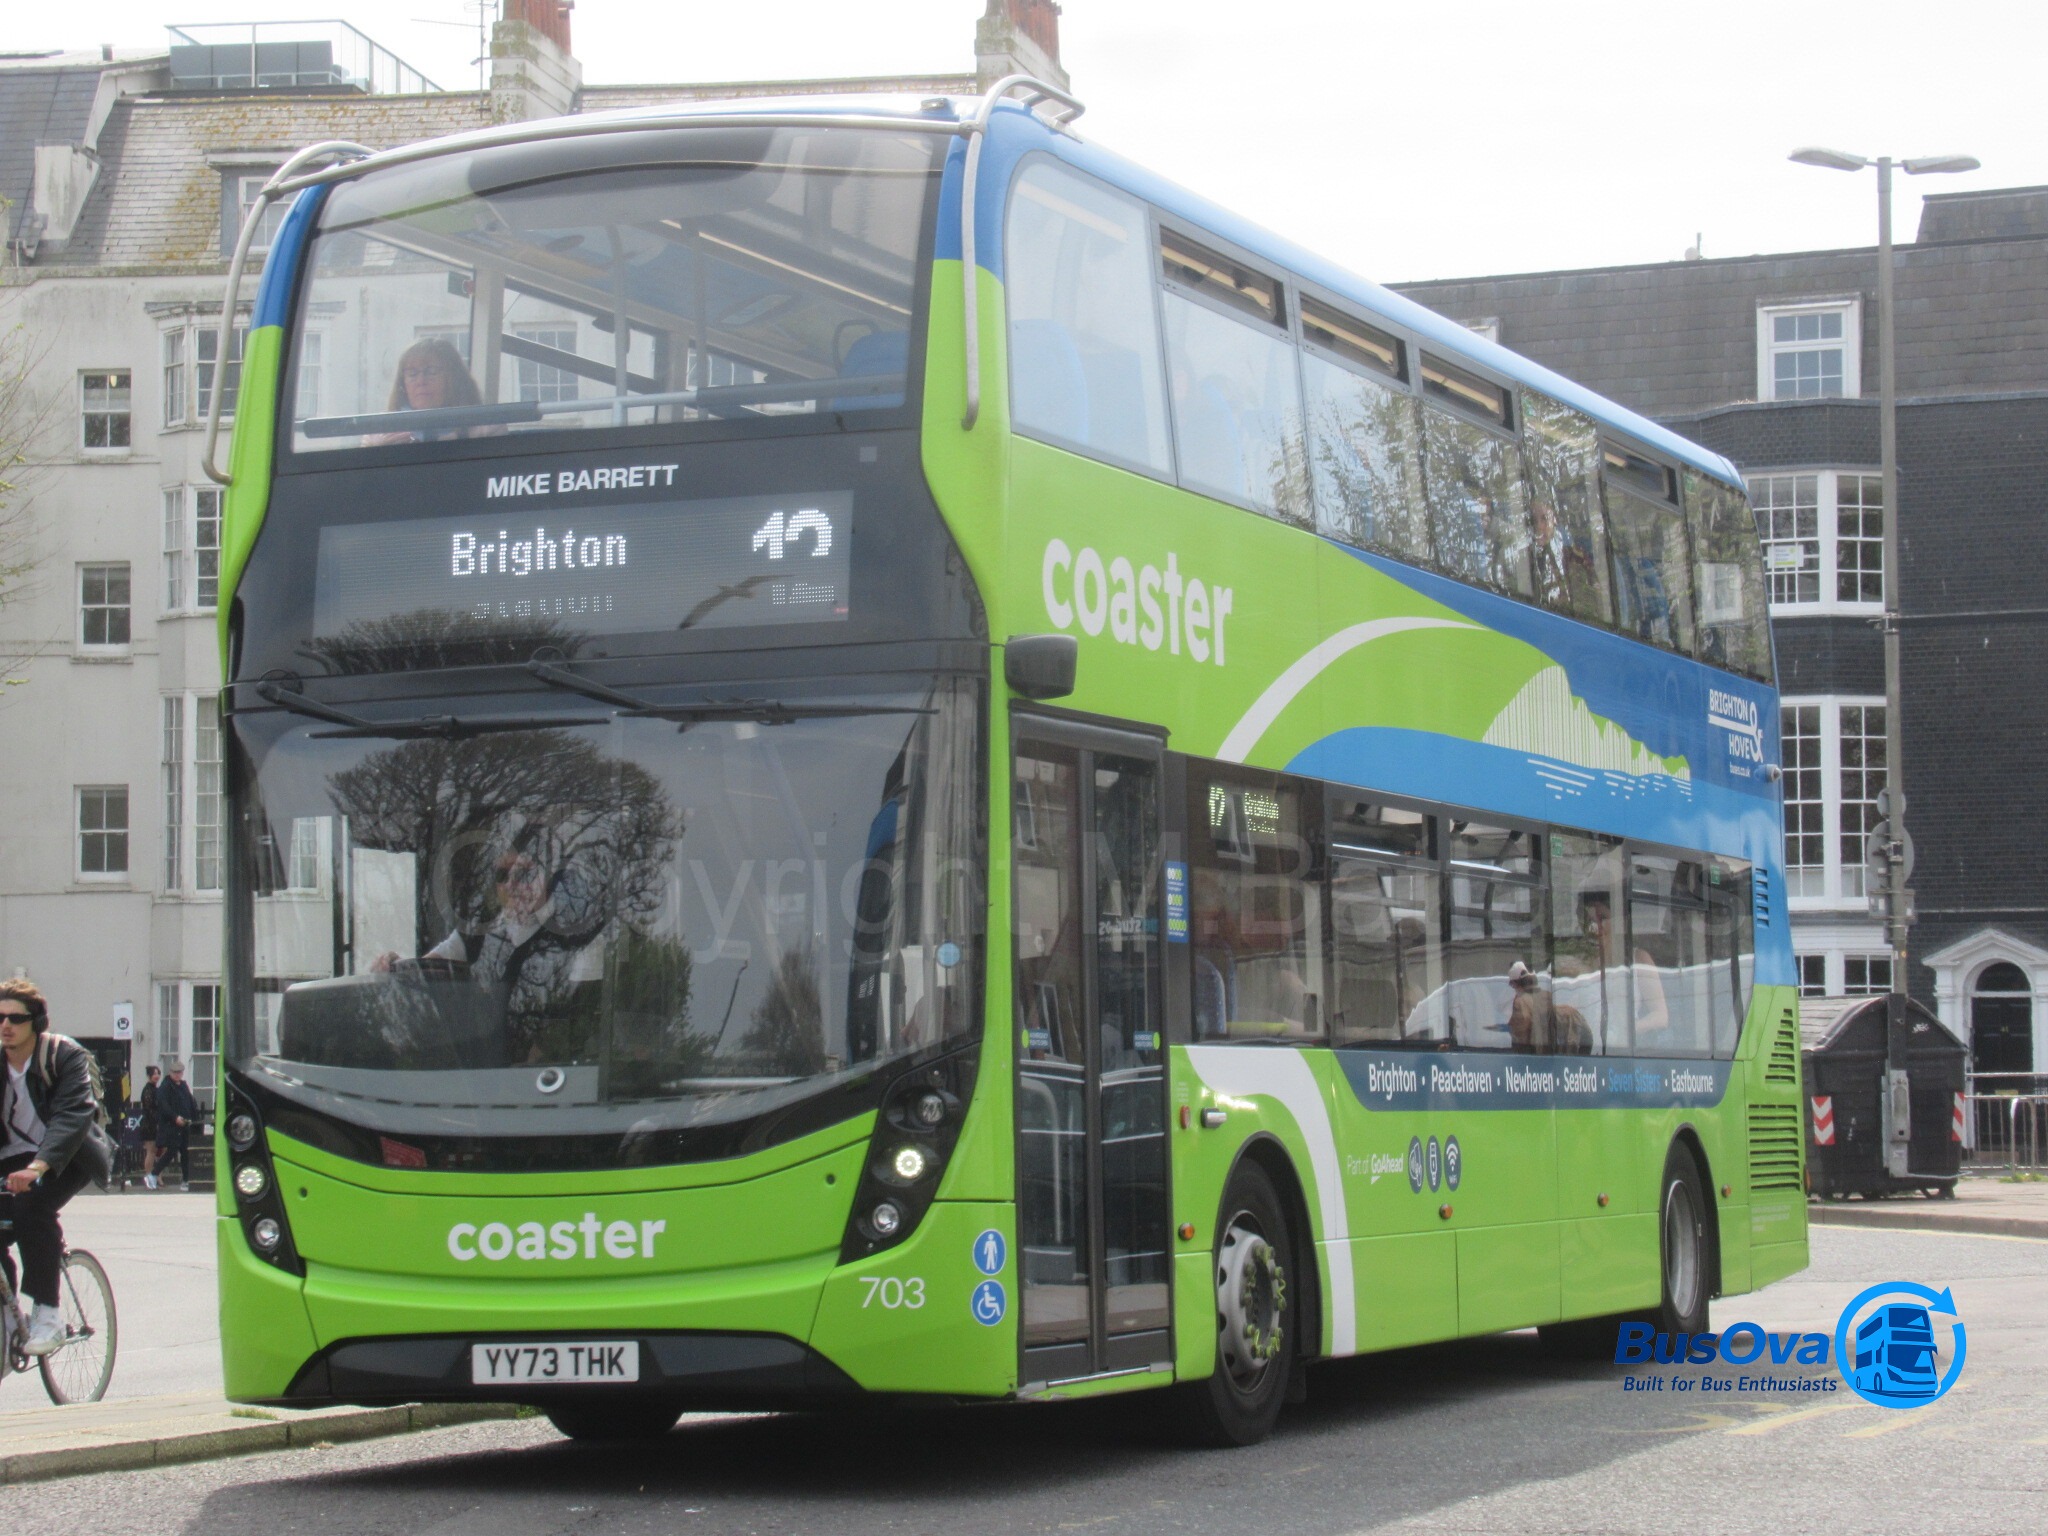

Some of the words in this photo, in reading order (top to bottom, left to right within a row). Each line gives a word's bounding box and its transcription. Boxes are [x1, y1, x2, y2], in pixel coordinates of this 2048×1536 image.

[486, 472, 550, 498] MIKE
[556, 464, 679, 493] BARRETT
[452, 528, 627, 576] Brighton
[1041, 538, 1233, 667] coaster
[1709, 688, 1749, 721] BRIGHTON
[1728, 733, 1750, 759] HOVE
[1369, 1061, 1417, 1100] Brighton
[1431, 1064, 1492, 1093] Peacehaven
[1505, 1065, 1554, 1093] Newhaven
[1563, 1065, 1597, 1093] Seaford
[1608, 1068, 1633, 1093] Seven
[1634, 1068, 1661, 1093] Sisters
[1671, 1068, 1714, 1094] Eastbourne
[447, 1212, 666, 1262] coaster
[858, 1277, 926, 1309] 703
[485, 1347, 560, 1377] YY73
[568, 1346, 626, 1376] THK
